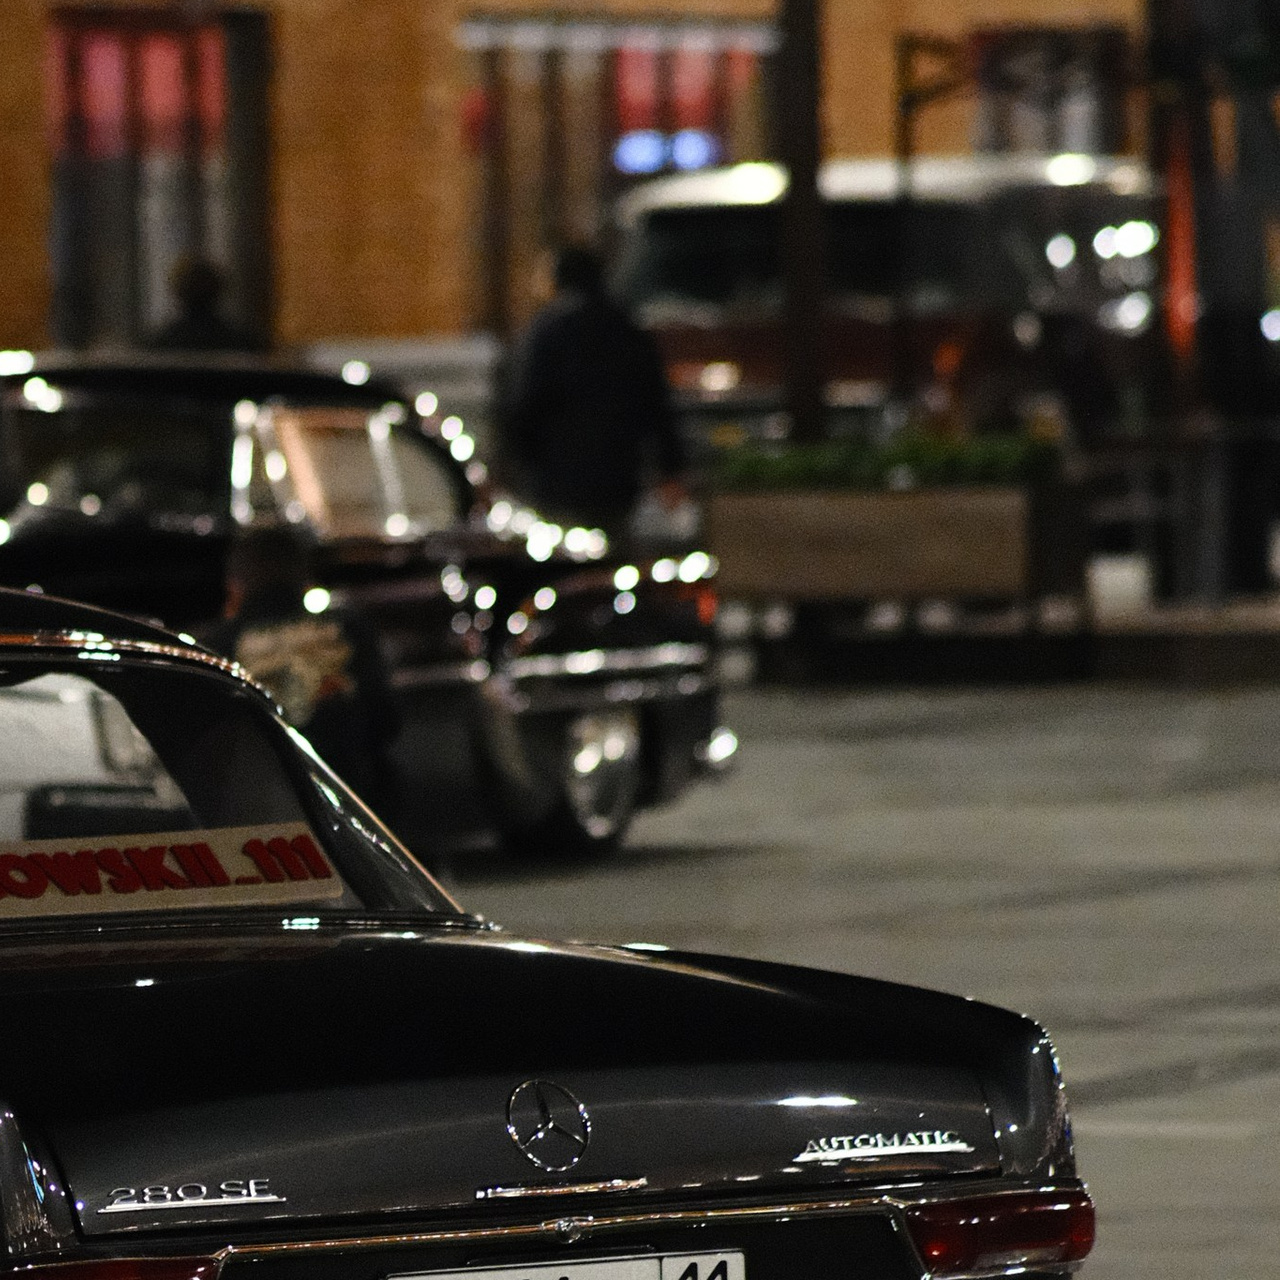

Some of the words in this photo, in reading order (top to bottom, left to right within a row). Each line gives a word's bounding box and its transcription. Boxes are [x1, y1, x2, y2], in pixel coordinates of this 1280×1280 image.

[804, 1130, 961, 1154] AUTOMATIC
[107, 1182, 208, 1206] 280
[219, 1178, 272, 1199] SE
